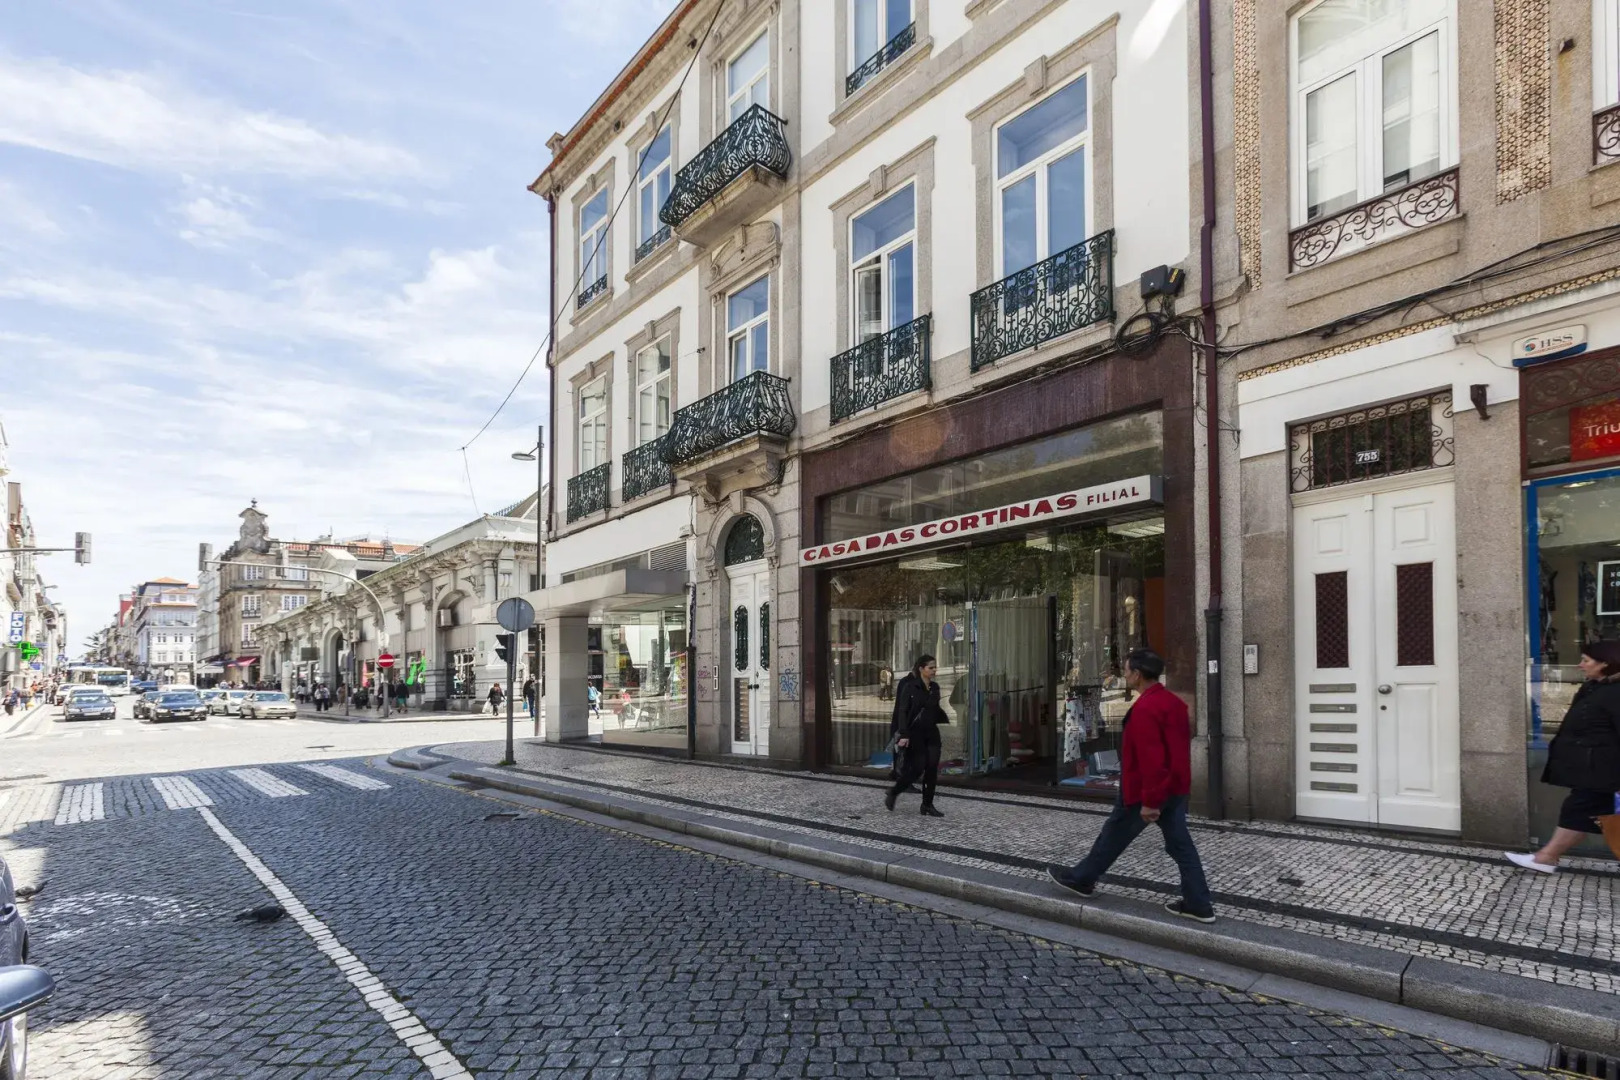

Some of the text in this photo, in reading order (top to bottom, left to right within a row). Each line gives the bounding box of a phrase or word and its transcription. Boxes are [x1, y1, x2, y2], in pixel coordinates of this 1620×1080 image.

[1357, 451, 1378, 462] 755
[803, 486, 1140, 562] CASA DAS CORTINAS FILIAL
[10, 613, 24, 642] FOTO
